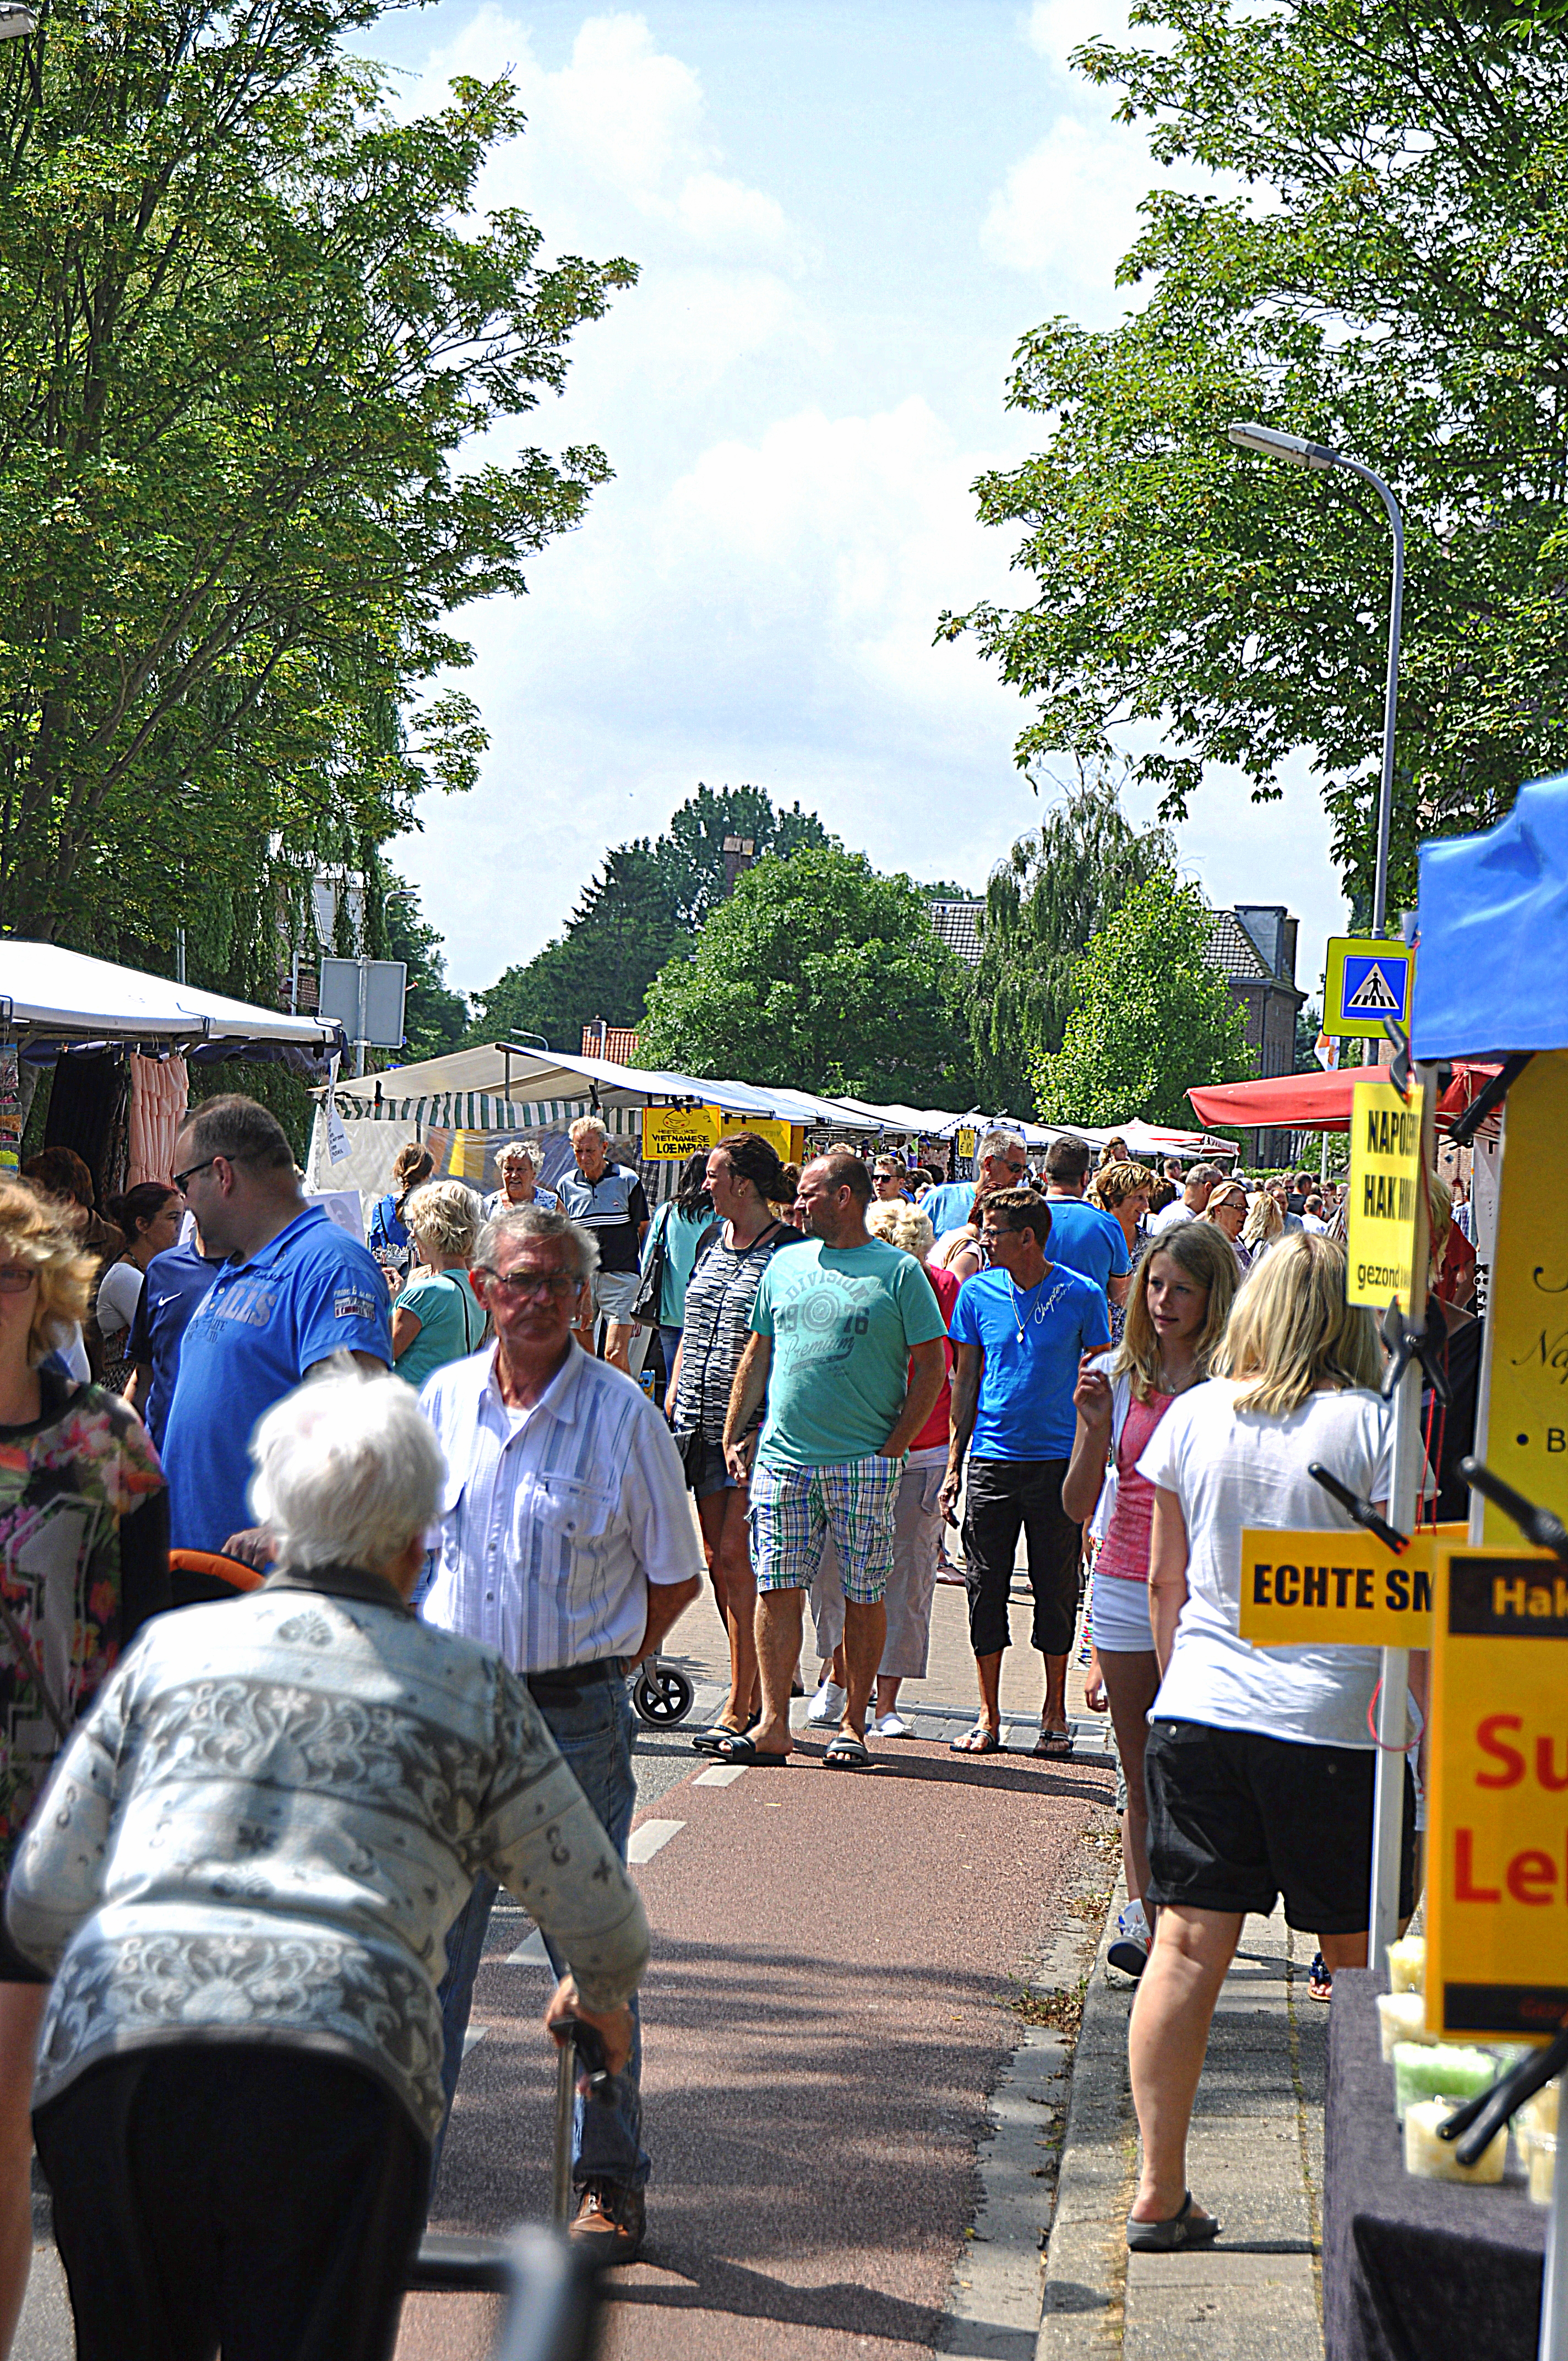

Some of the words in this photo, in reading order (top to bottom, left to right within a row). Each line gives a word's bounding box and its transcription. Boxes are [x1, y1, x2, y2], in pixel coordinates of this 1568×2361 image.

[652, 1134, 710, 1143] VIETNAMESE
[1364, 1174, 1397, 1220] HAK
[786, 1270, 870, 1303] DIVISION
[1358, 1263, 1400, 1290] gezond
[843, 1303, 870, 1335] 76
[784, 1334, 854, 1367] Premium
[1254, 1564, 1375, 1610] ECHTE
[1454, 1828, 1568, 1906] Le
